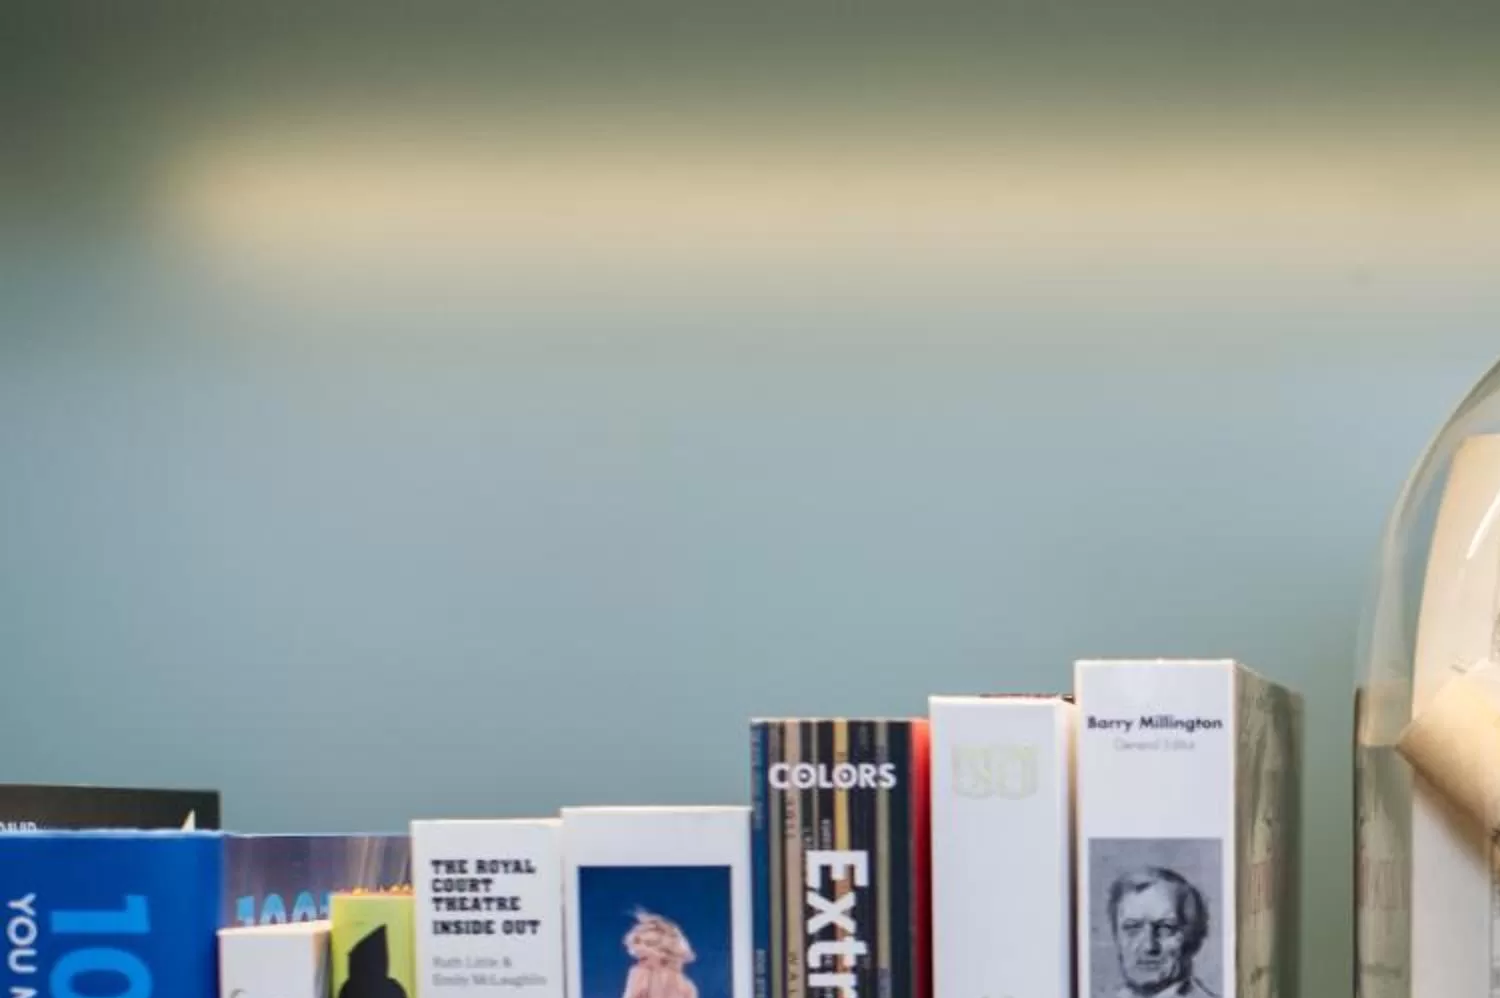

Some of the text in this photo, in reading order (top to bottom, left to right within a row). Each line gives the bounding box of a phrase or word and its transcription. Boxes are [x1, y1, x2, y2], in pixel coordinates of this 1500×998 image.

[1086, 714, 1224, 733] Barry Millington
[768, 762, 897, 791] COLORS
[430, 858, 536, 875] THE ROYAL
[431, 877, 493, 893] COURT
[431, 895, 522, 912] THEATRE
[6, 892, 39, 975] YOU
[431, 919, 542, 935] INSIDE OUT
